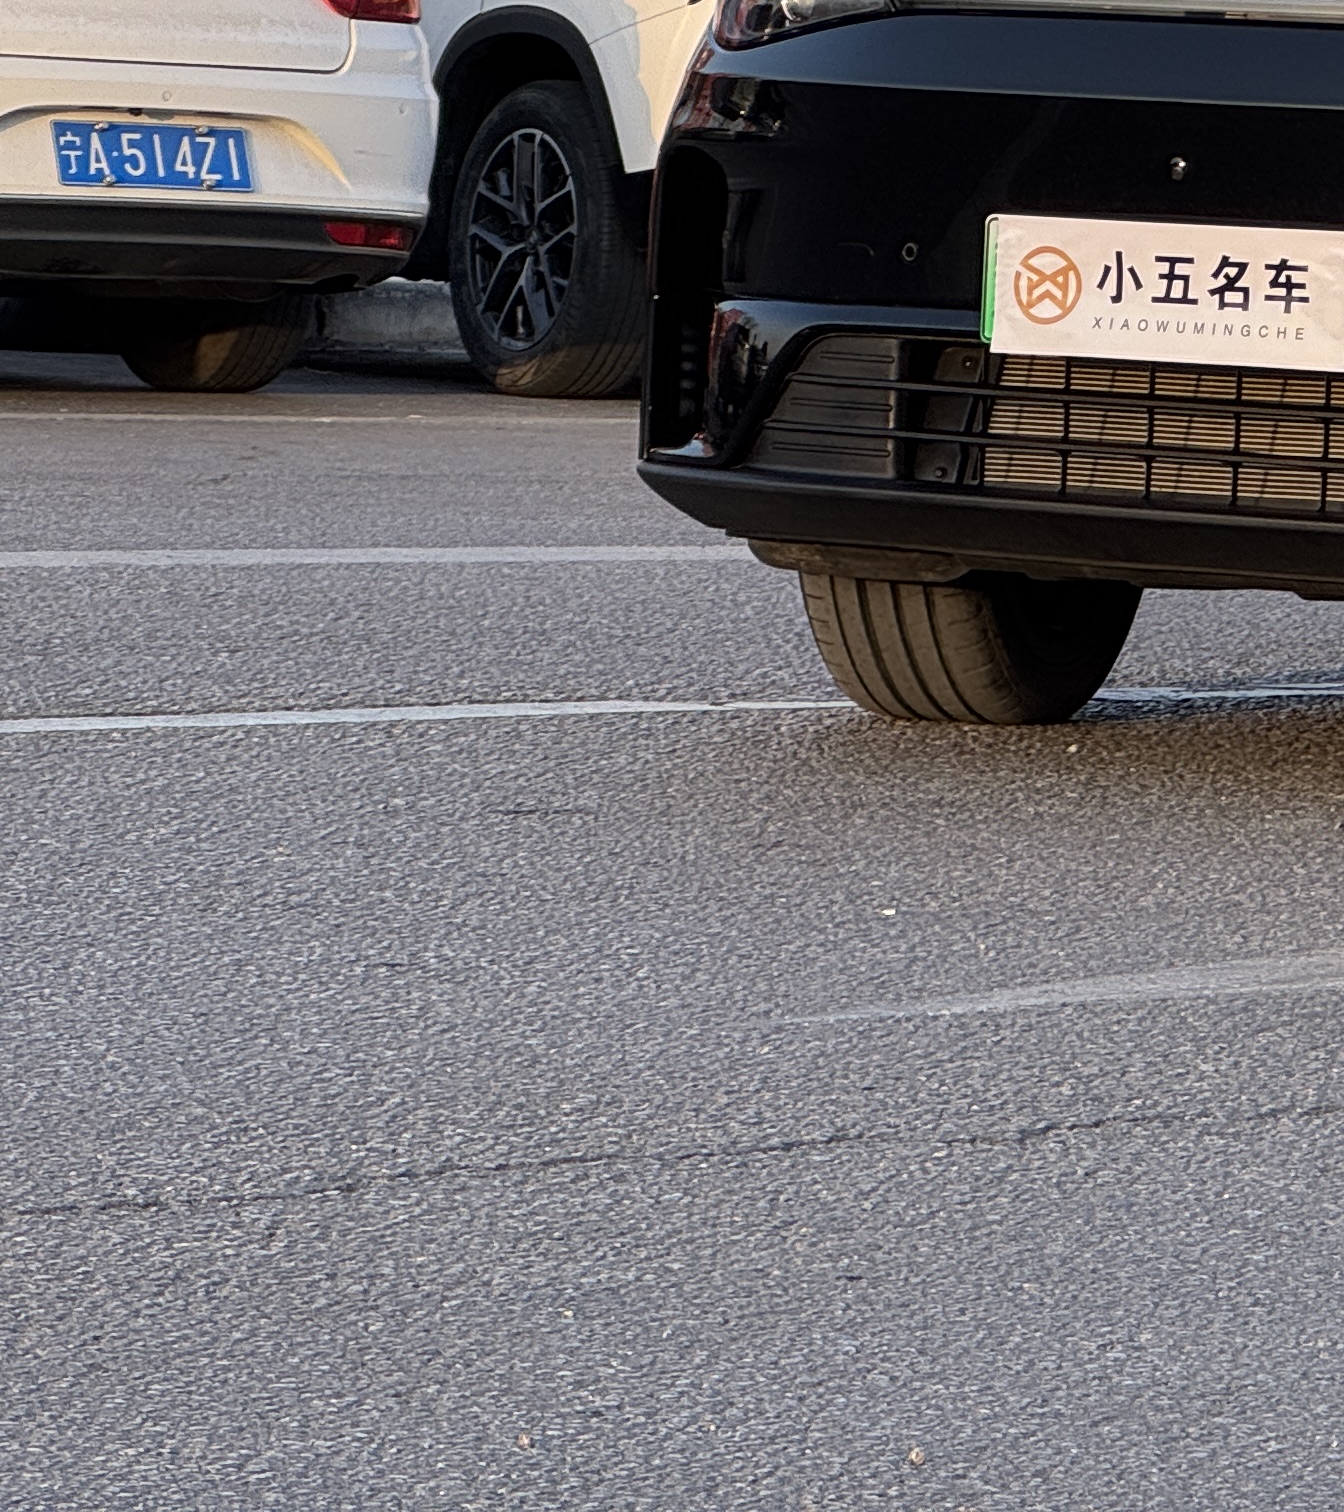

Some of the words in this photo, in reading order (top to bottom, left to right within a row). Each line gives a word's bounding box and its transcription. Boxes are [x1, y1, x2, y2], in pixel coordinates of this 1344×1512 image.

[1096, 250, 1311, 314] 小五名车
[1091, 316, 1306, 341] XIAOWUMINGCHE
